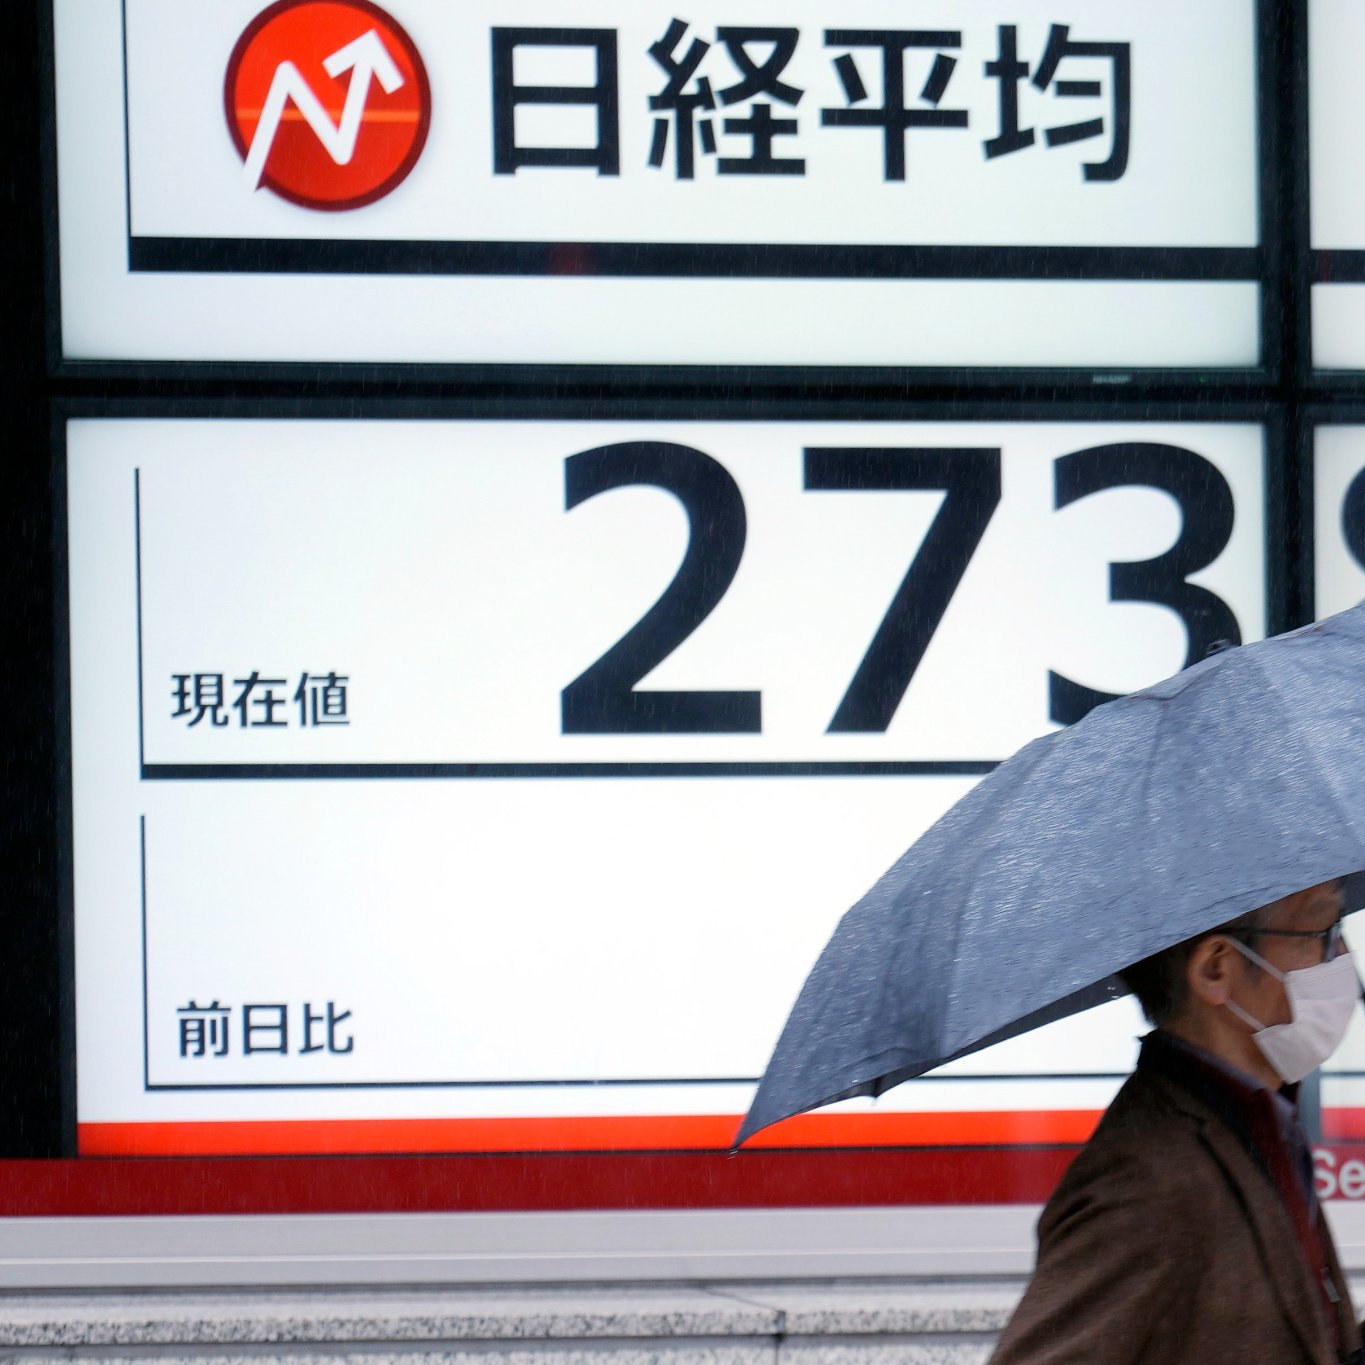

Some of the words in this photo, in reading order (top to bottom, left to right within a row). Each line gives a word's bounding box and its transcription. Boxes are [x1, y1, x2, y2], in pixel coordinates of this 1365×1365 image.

[491, 18, 1132, 183] 日経平均
[171, 671, 350, 728] 現在値
[176, 1000, 354, 1057] 前日比
